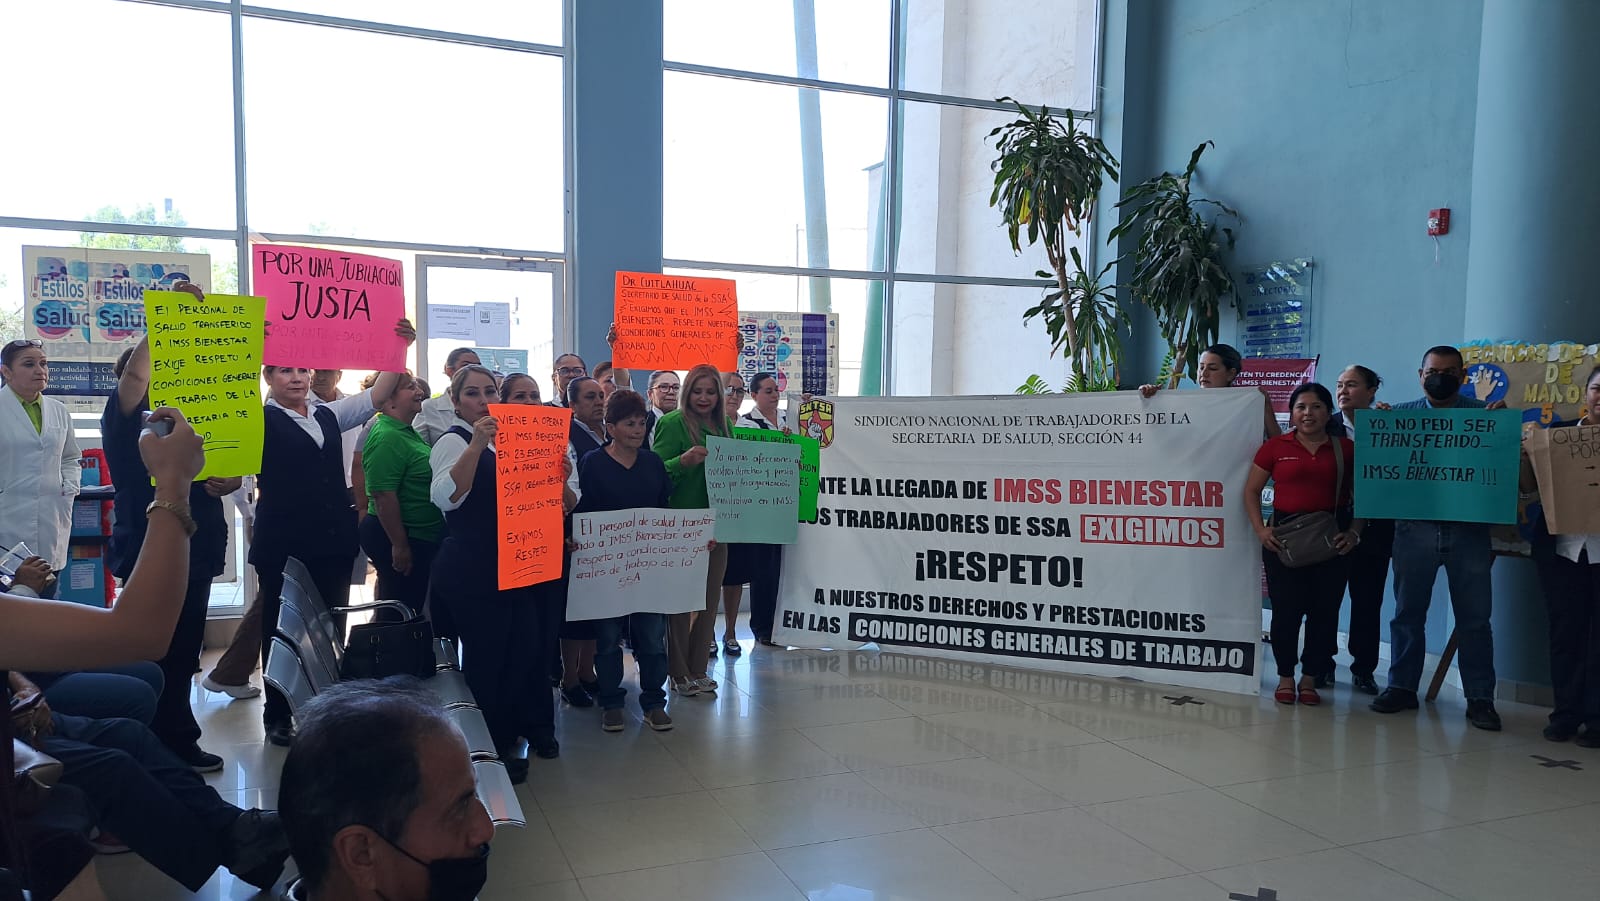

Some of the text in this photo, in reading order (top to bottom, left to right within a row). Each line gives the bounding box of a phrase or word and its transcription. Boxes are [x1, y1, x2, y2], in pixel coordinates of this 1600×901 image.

[258, 250, 402, 287] POR UNA JUBILACIÓN
[281, 281, 371, 322] JUSTA
[621, 289, 659, 301] SECRETARIO
[662, 292, 671, 301] DE
[672, 292, 692, 302] SALUD
[712, 294, 728, 304] SSA
[178, 304, 227, 316] PERSONAL
[233, 305, 245, 315] DE
[629, 303, 714, 318] EXIGIMOS QUE EL IMSS
[154, 320, 252, 335] SALUD TRANSFERIDO
[621, 315, 664, 326] BIENESTAR
[673, 317, 704, 329] RESPETE
[620, 328, 724, 340] CONDICIONES GENERALES DE
[155, 336, 249, 350] A IMSS BIENESTAR
[619, 342, 656, 352] TRABAJO
[195, 353, 239, 364] RESPETO
[246, 353, 253, 362] A
[1545, 362, 1574, 385] DE
[153, 376, 217, 391] CONDICIONES
[155, 400, 167, 408] DE
[226, 391, 239, 400] DE
[244, 389, 257, 398] LA
[235, 409, 248, 418] DE
[800, 401, 833, 415] SNTSA
[1540, 402, 1553, 425] 5
[498, 414, 527, 425] VIENE
[532, 417, 538, 425] A
[854, 412, 1191, 429] SINDICATO NACIONAL DE TRABAJADORES DE LA
[1395, 418, 1417, 431] NO
[1421, 418, 1453, 431] PEDI
[1463, 418, 1497, 434] SER
[515, 431, 532, 441] IMSS
[892, 429, 1143, 447] SECRETARIA DE SALUD, SECCIÓN 44
[498, 449, 525, 460] EN 23
[1409, 450, 1429, 464] AL
[498, 467, 509, 476] VA
[513, 465, 519, 473] A
[1362, 464, 1400, 480] IMSS
[1405, 466, 1476, 482] BIENESTAR
[851, 477, 873, 497] LA
[876, 478, 958, 499] LLEGADA
[962, 480, 988, 500] DE
[994, 478, 1062, 505] IMSS
[1069, 479, 1225, 508] BIENESTAR
[506, 505, 514, 516] DE
[599, 511, 636, 537] personal
[638, 513, 648, 526] de
[652, 514, 676, 527] salud
[834, 509, 990, 535] TRABAJADORES
[994, 515, 1021, 536] DE
[1026, 516, 1071, 538] SSA
[1083, 516, 1220, 546] EXIGIMOS
[598, 541, 605, 549] a
[515, 545, 547, 561] RESPETO
[577, 543, 688, 568] respeto a condiciones
[610, 564, 621, 576] de
[625, 557, 659, 574] trabajo
[661, 560, 675, 570] de
[681, 558, 693, 568] la
[914, 549, 1084, 589] ¡RESPETO!
[814, 588, 1207, 633] A NUESTROS DERECHOS Y PRESTACIONES
[783, 609, 1245, 671] EN LAS CONDICIONES GENERALES DE TRABAJO
